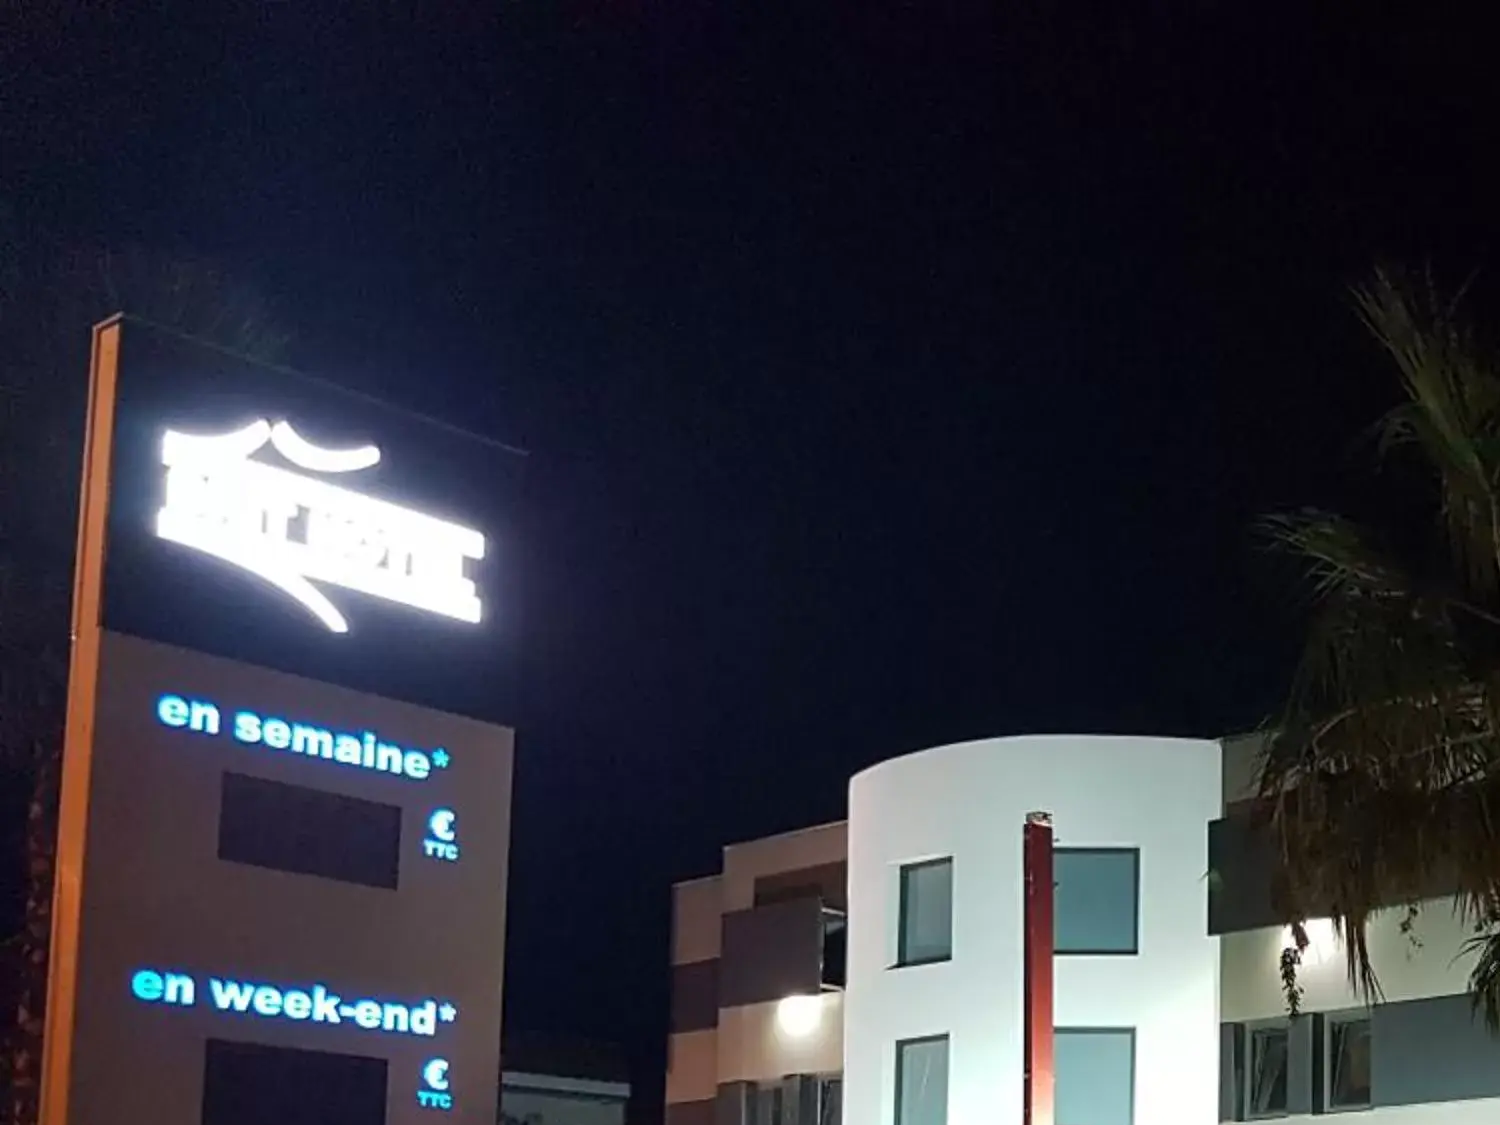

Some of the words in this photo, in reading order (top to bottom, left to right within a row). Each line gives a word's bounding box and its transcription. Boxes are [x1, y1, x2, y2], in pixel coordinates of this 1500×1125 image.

[157, 694, 220, 735] en
[429, 808, 456, 842] €
[423, 839, 458, 860] TTC
[132, 968, 195, 1006] en
[422, 1058, 449, 1091] €
[417, 1090, 452, 1109] TTC
